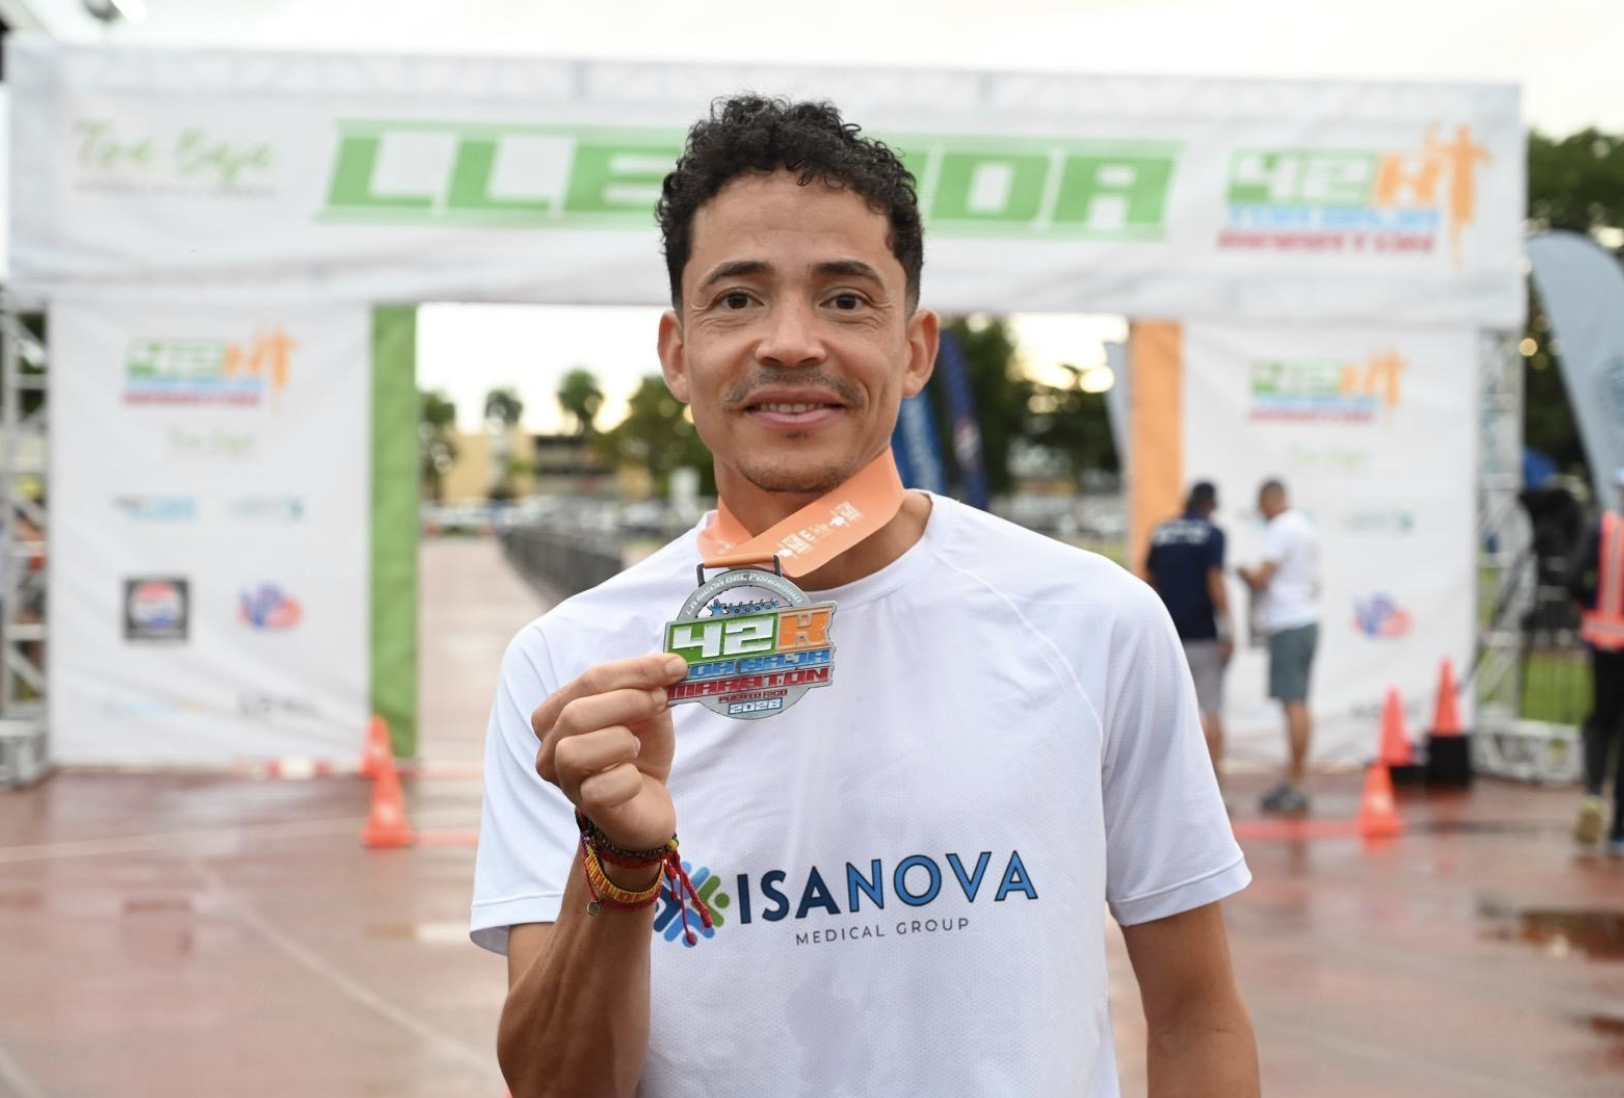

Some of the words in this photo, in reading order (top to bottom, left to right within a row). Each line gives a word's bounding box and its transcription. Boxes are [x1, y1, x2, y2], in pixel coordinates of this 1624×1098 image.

[320, 125, 1176, 232] LLEDA
[672, 611, 830, 658] 42K
[689, 660, 736, 679] OA
[736, 850, 1039, 925] ISANOVA
[795, 923, 885, 946] MEDICAL
[895, 917, 970, 936] GROUP
